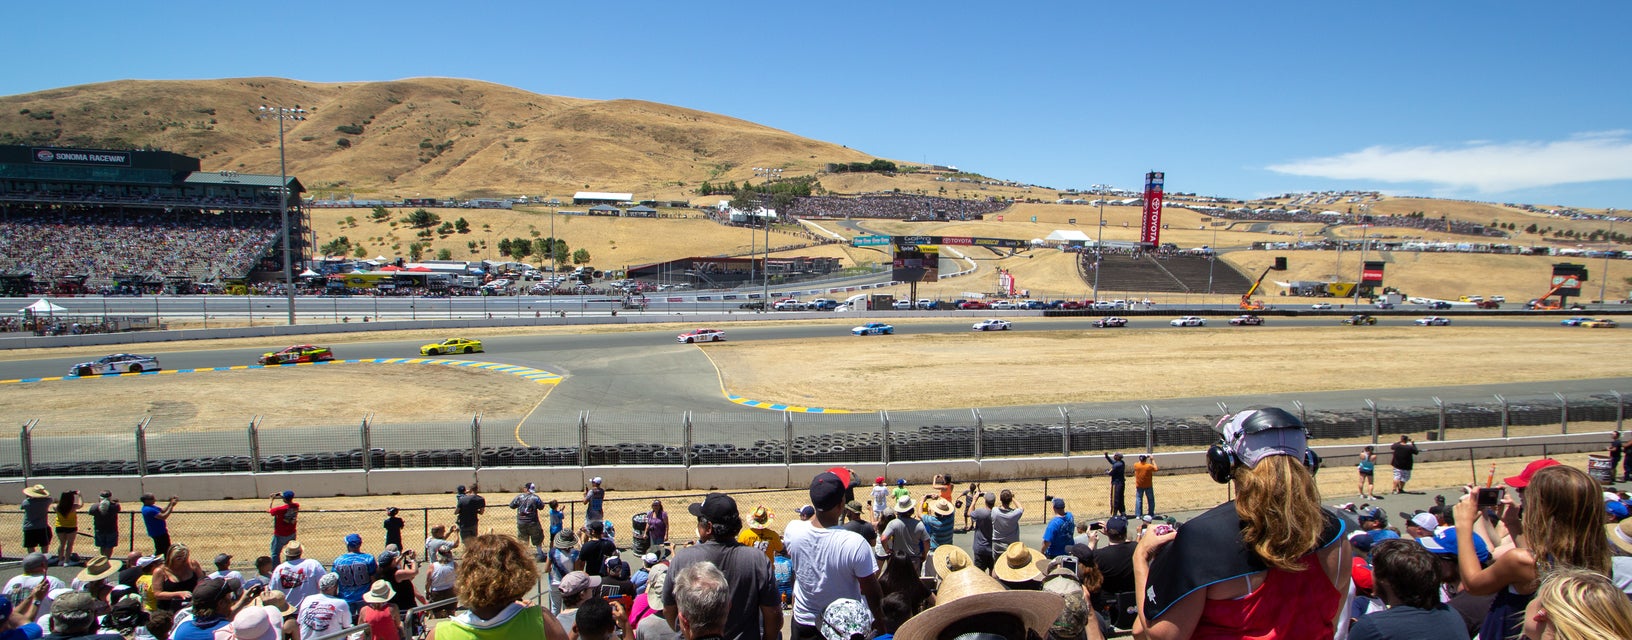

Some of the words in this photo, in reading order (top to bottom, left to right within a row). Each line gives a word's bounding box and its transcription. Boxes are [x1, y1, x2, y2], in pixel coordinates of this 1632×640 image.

[56, 153, 88, 161] SONOMA
[1150, 211, 1158, 242] TOYOTA
[337, 562, 370, 586] 88
